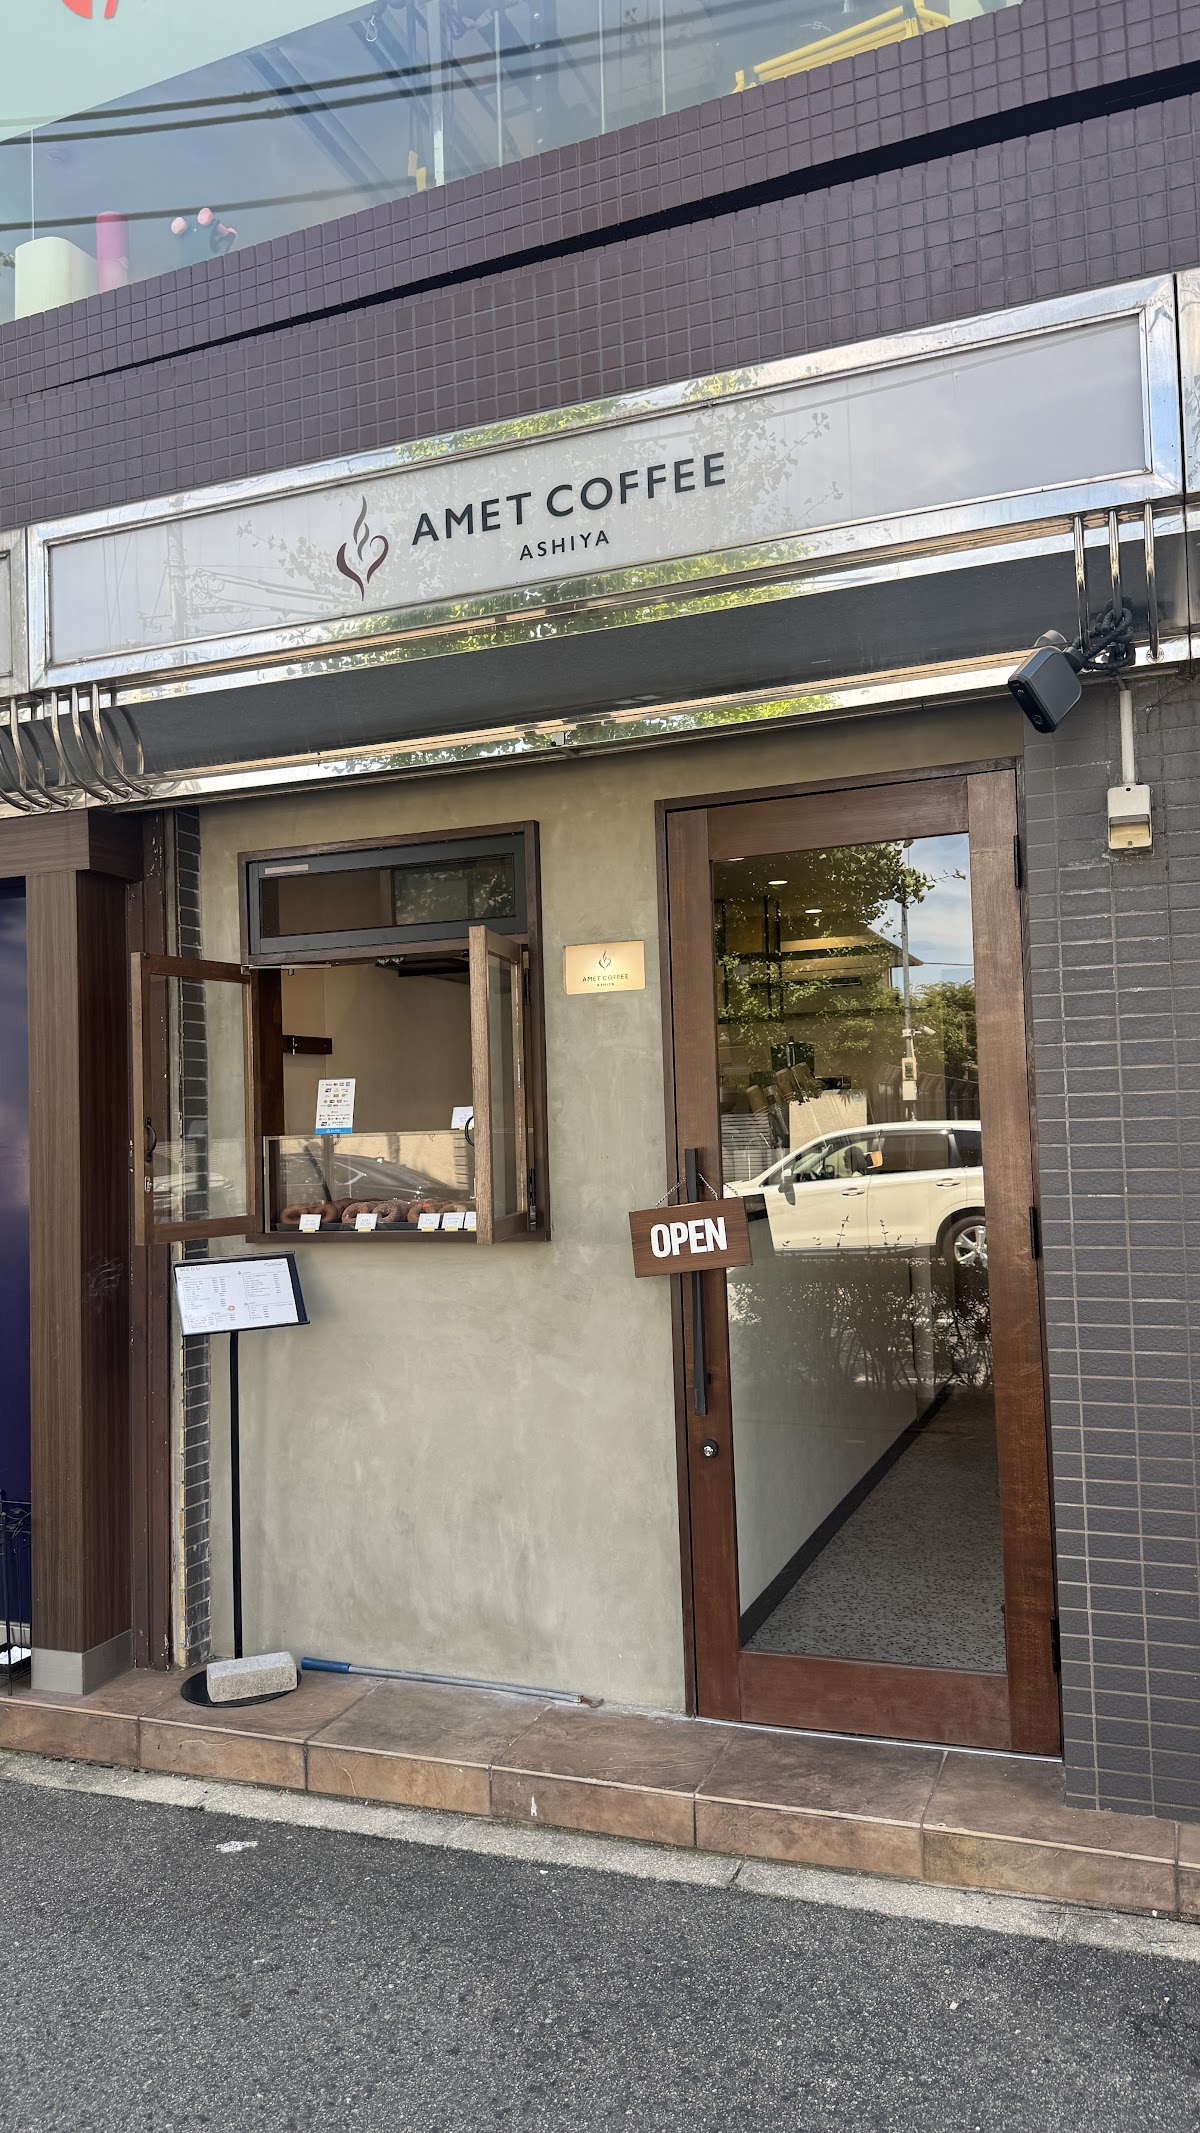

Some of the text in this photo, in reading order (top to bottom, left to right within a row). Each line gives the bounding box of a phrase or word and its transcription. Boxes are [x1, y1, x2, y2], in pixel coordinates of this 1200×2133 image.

[412, 452, 726, 546] AMET COFFEE
[519, 530, 610, 561] ASHIYA
[602, 973, 629, 981] COFFEE
[650, 1216, 728, 1258] OPEN
